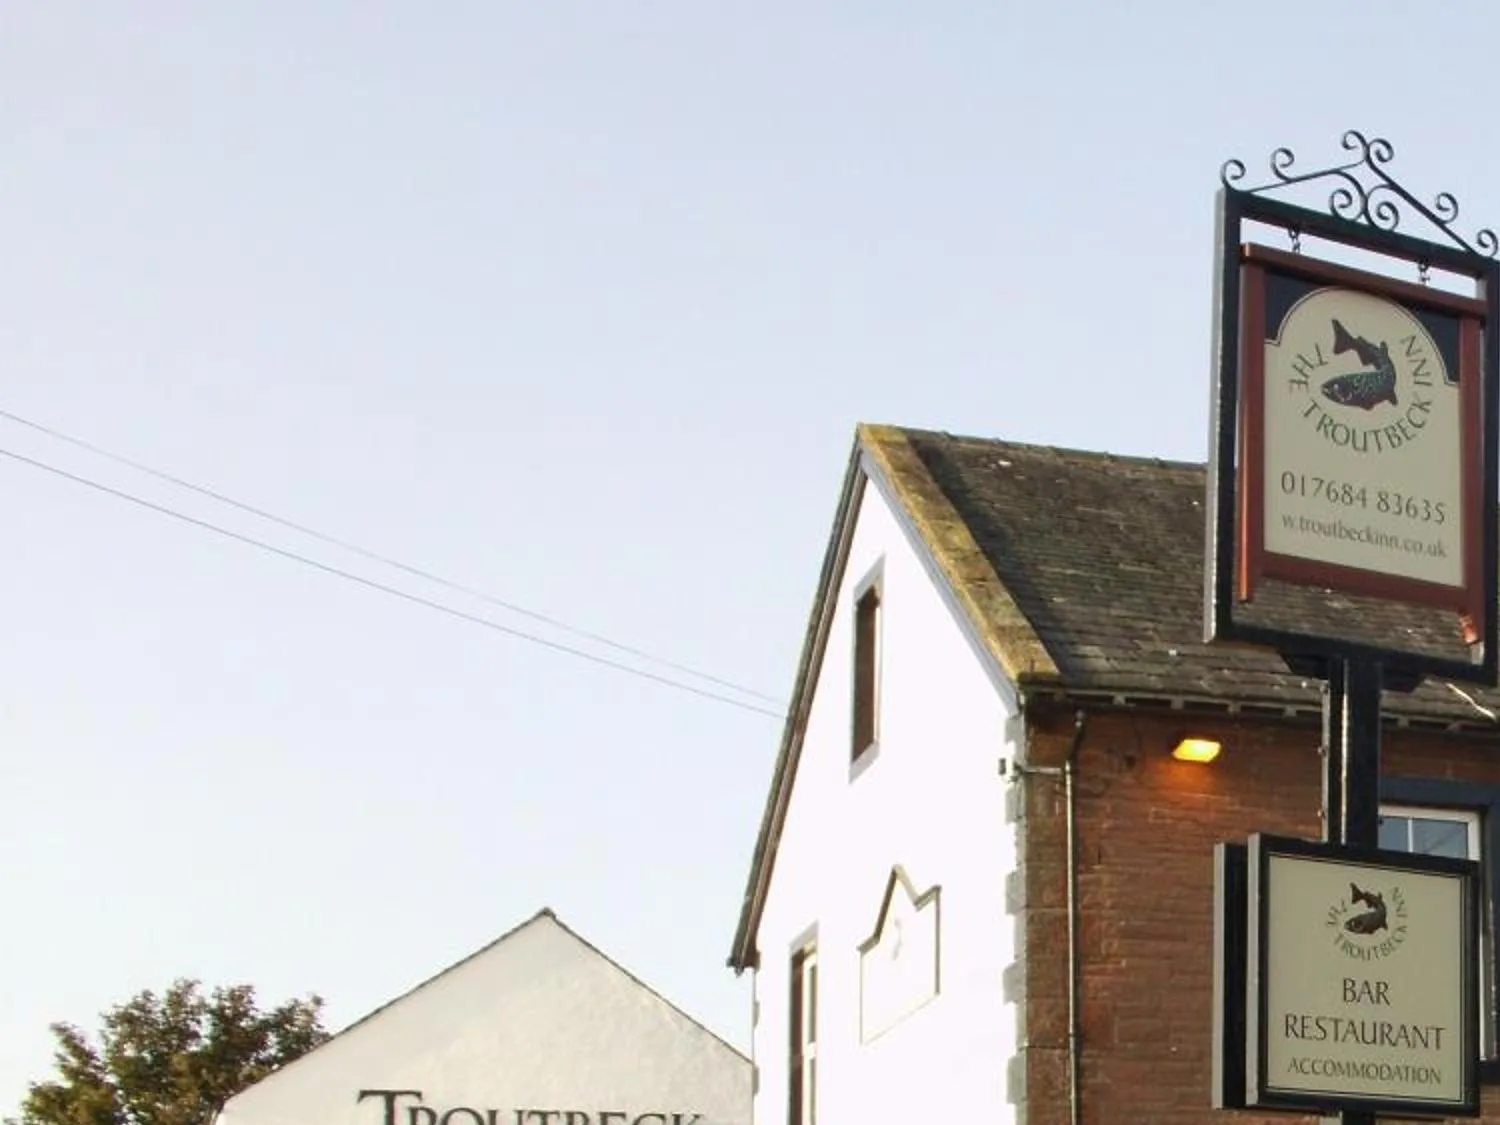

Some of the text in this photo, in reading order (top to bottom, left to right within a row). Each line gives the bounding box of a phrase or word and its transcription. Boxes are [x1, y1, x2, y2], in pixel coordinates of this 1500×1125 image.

[1289, 333, 1433, 453] THE TROUTBECK INN
[1281, 469, 1446, 526] 017684 83635
[1342, 976, 1391, 1006] BAR
[1283, 1013, 1446, 1051] RESTAURANT
[1286, 1056, 1442, 1085] ACCOMMODATION
